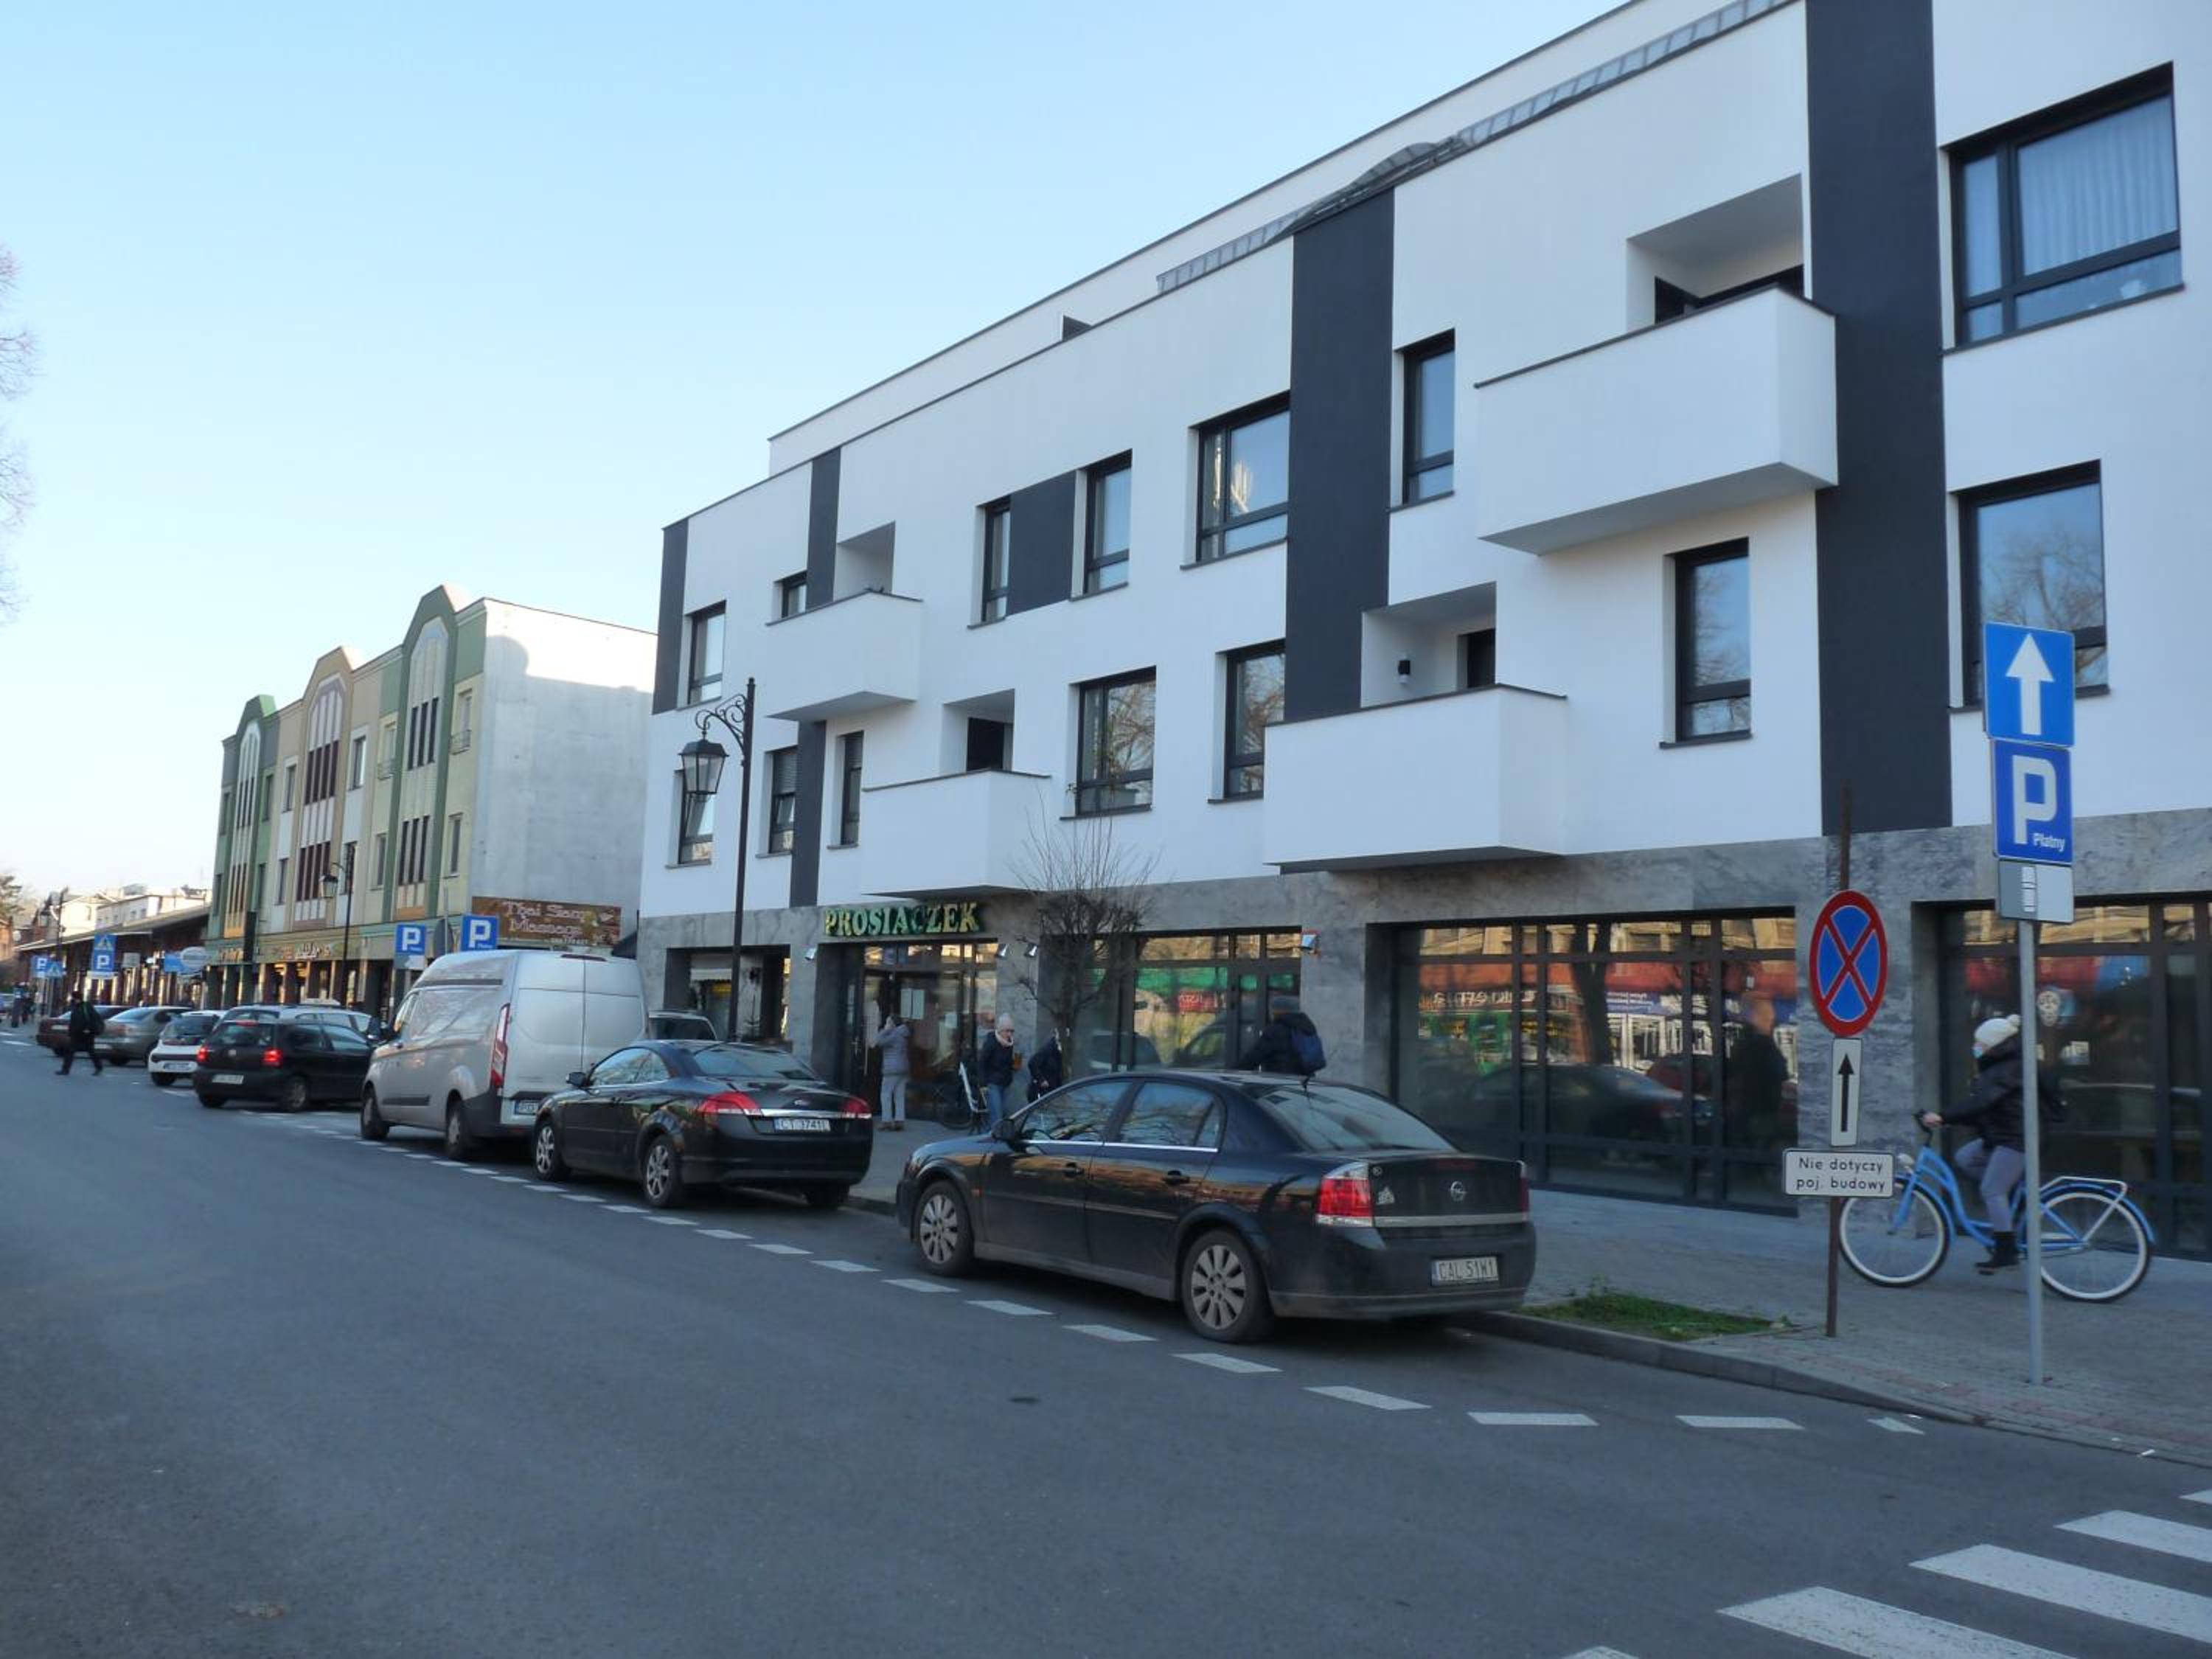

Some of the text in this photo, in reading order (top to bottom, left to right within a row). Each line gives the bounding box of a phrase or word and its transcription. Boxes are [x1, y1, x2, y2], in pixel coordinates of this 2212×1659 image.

[2012, 754, 2056, 844] P
[826, 902, 979, 936] PROSIACZEK
[402, 927, 420, 950] P
[469, 920, 491, 947] P
[97, 955, 110, 969] P
[1799, 1157, 1882, 1175] Nie dotyczy
[1831, 1177, 1885, 1192] budowy
